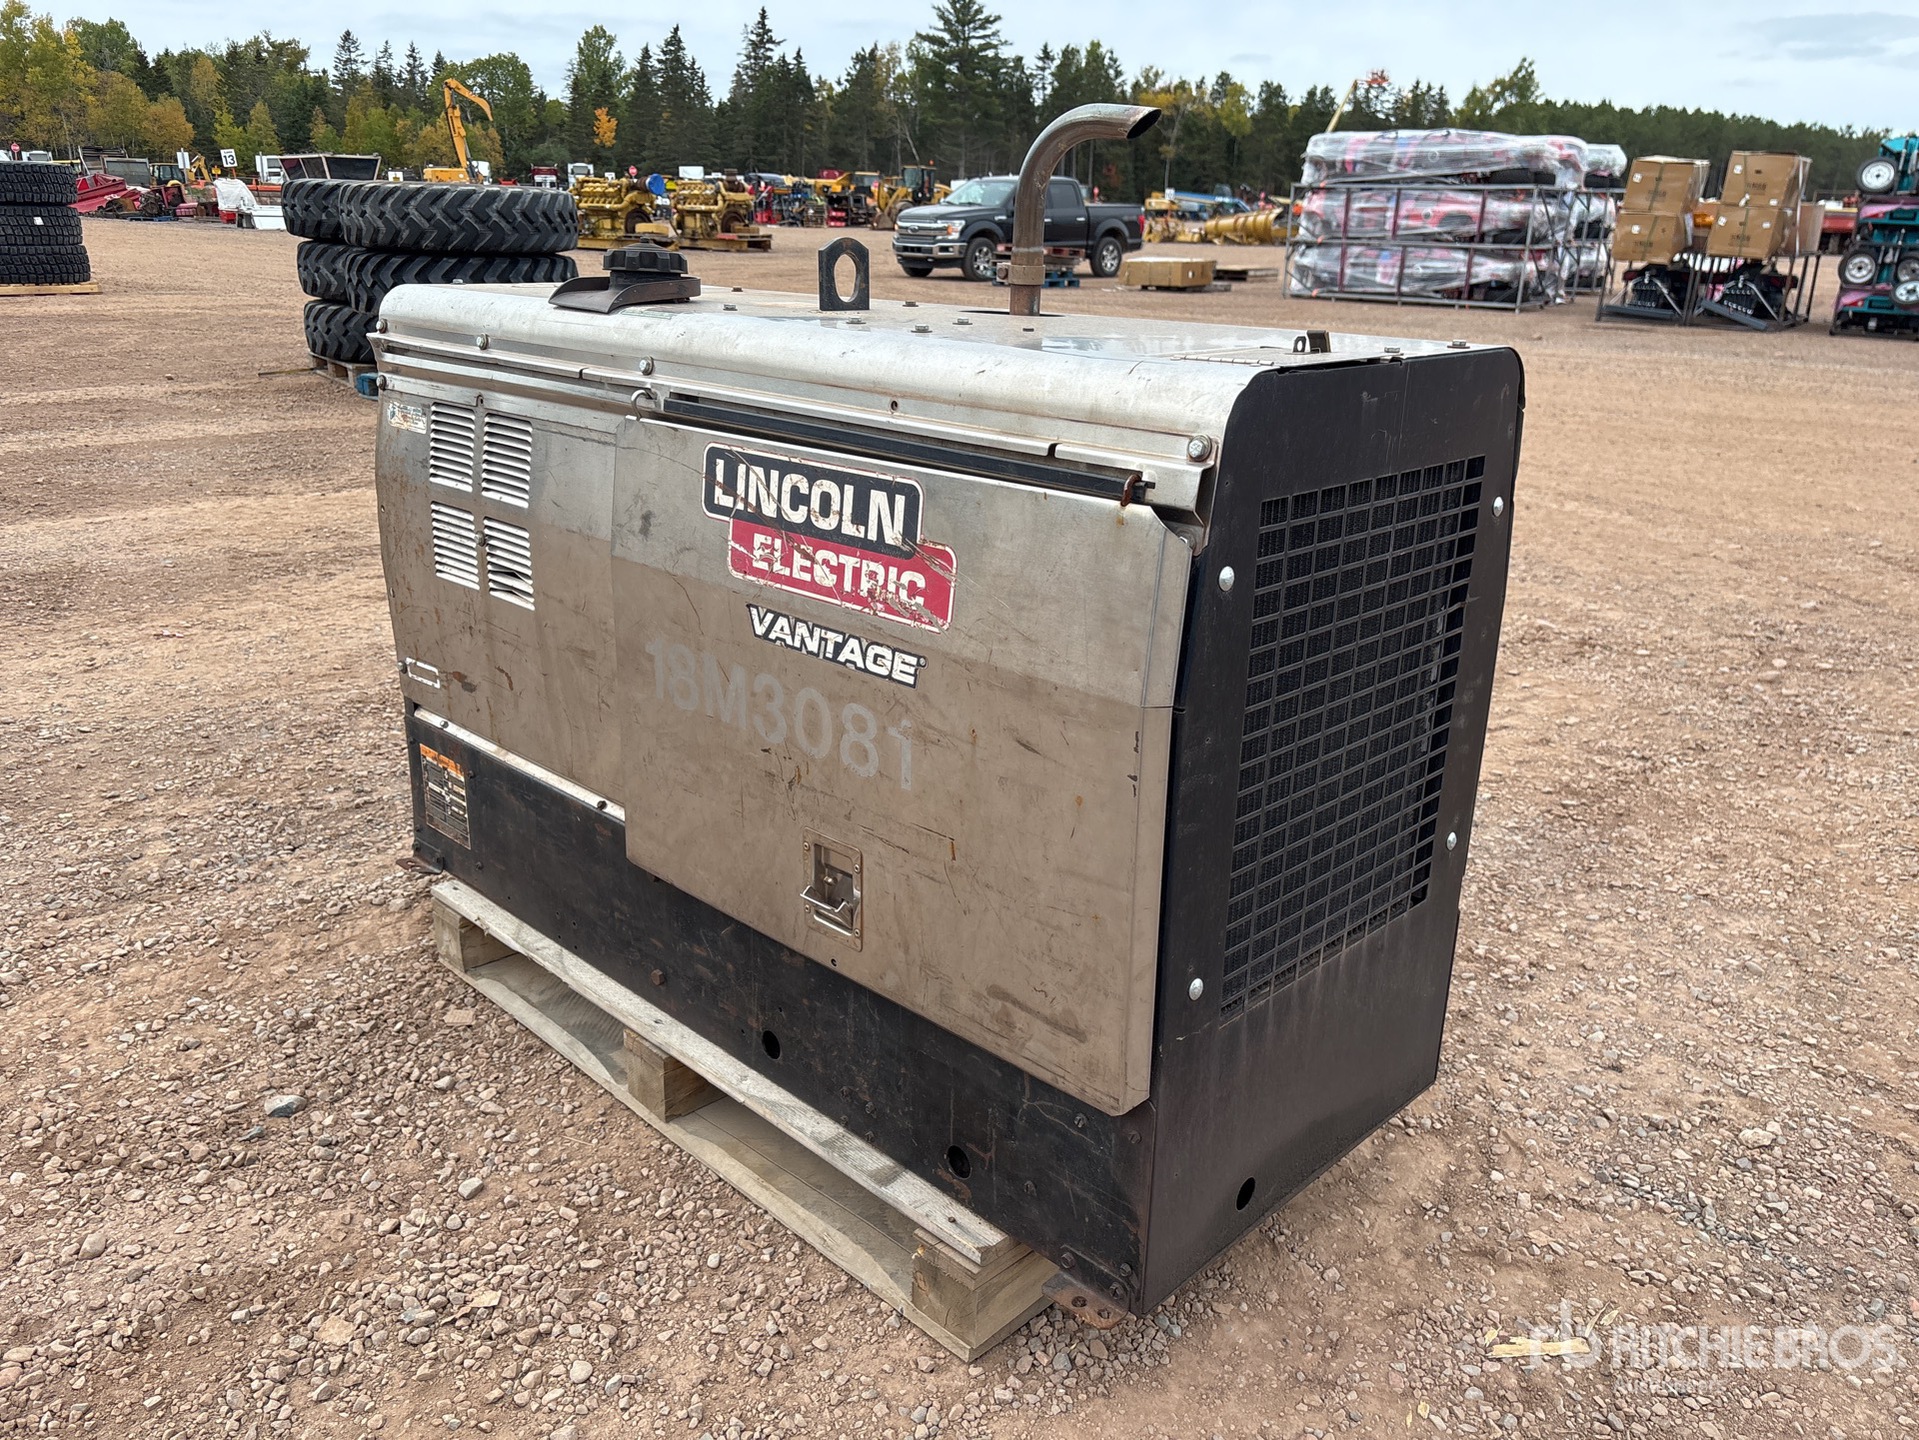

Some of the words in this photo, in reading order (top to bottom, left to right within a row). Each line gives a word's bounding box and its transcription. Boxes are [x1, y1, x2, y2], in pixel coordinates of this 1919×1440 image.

[223, 154, 235, 165] 13
[714, 458, 906, 546] LINCOLN
[752, 533, 926, 606] ELECTRIC
[750, 606, 919, 685] VANTAGE
[645, 638, 912, 790] 18M3081
